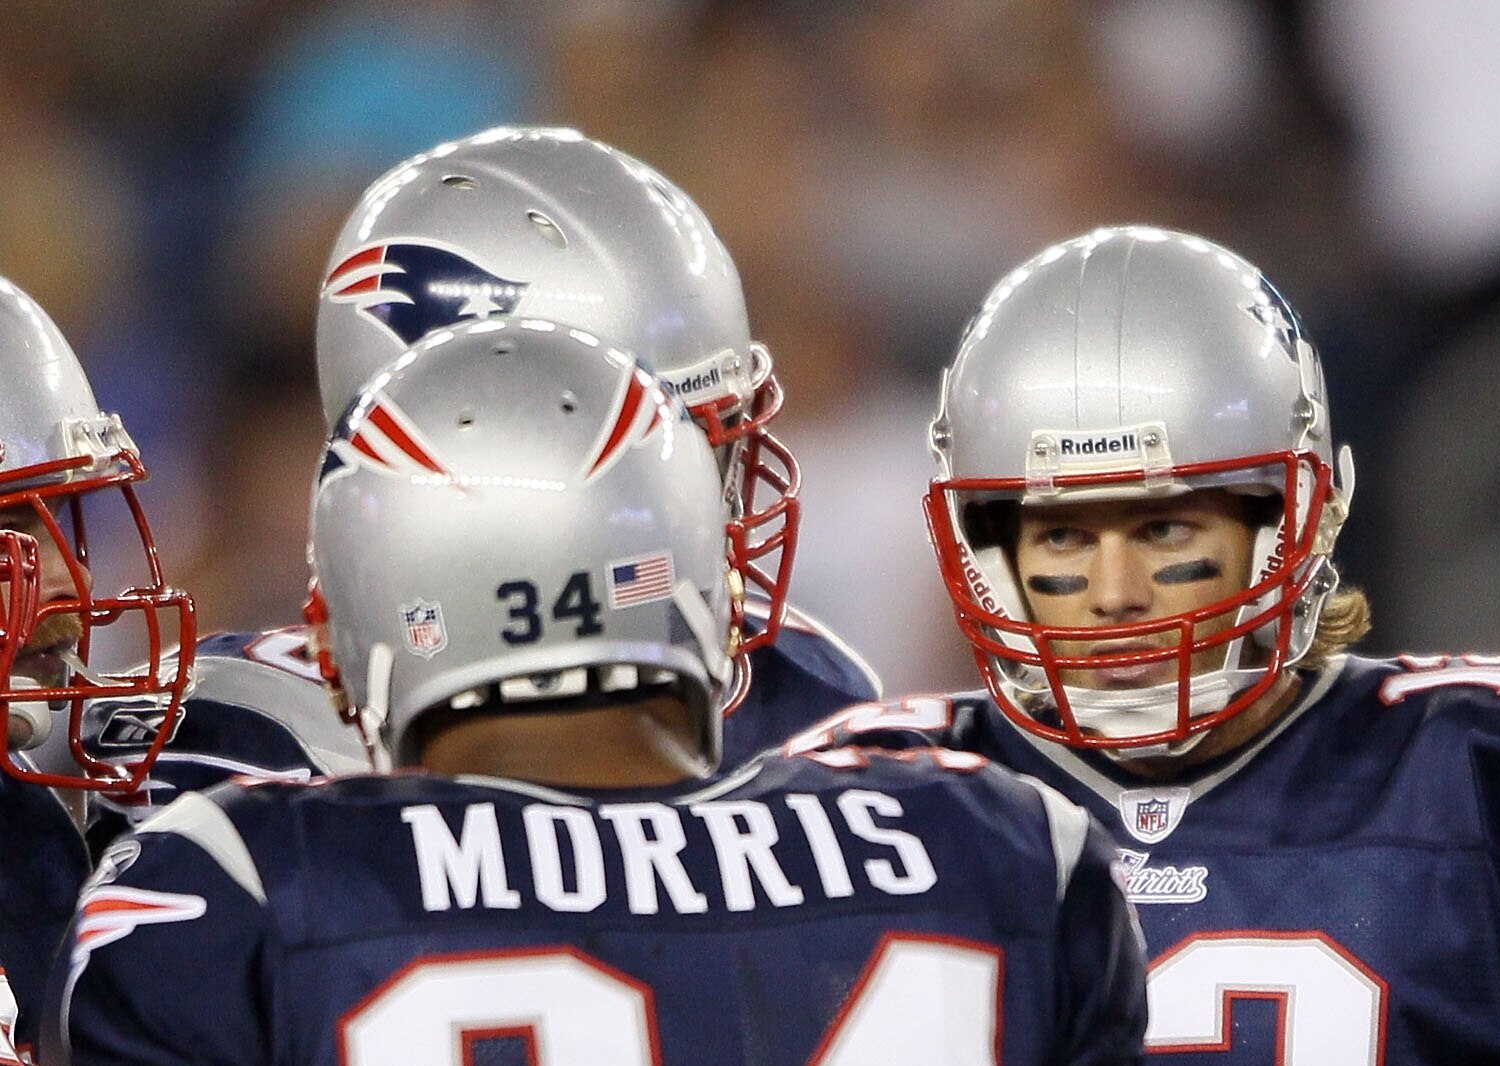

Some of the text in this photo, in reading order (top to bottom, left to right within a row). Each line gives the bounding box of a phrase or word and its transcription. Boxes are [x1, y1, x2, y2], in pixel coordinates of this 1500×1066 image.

[1061, 434, 1136, 457] Riddell
[497, 571, 605, 644] 34
[1138, 813, 1166, 830] NFL
[401, 789, 938, 915] MORRIS
